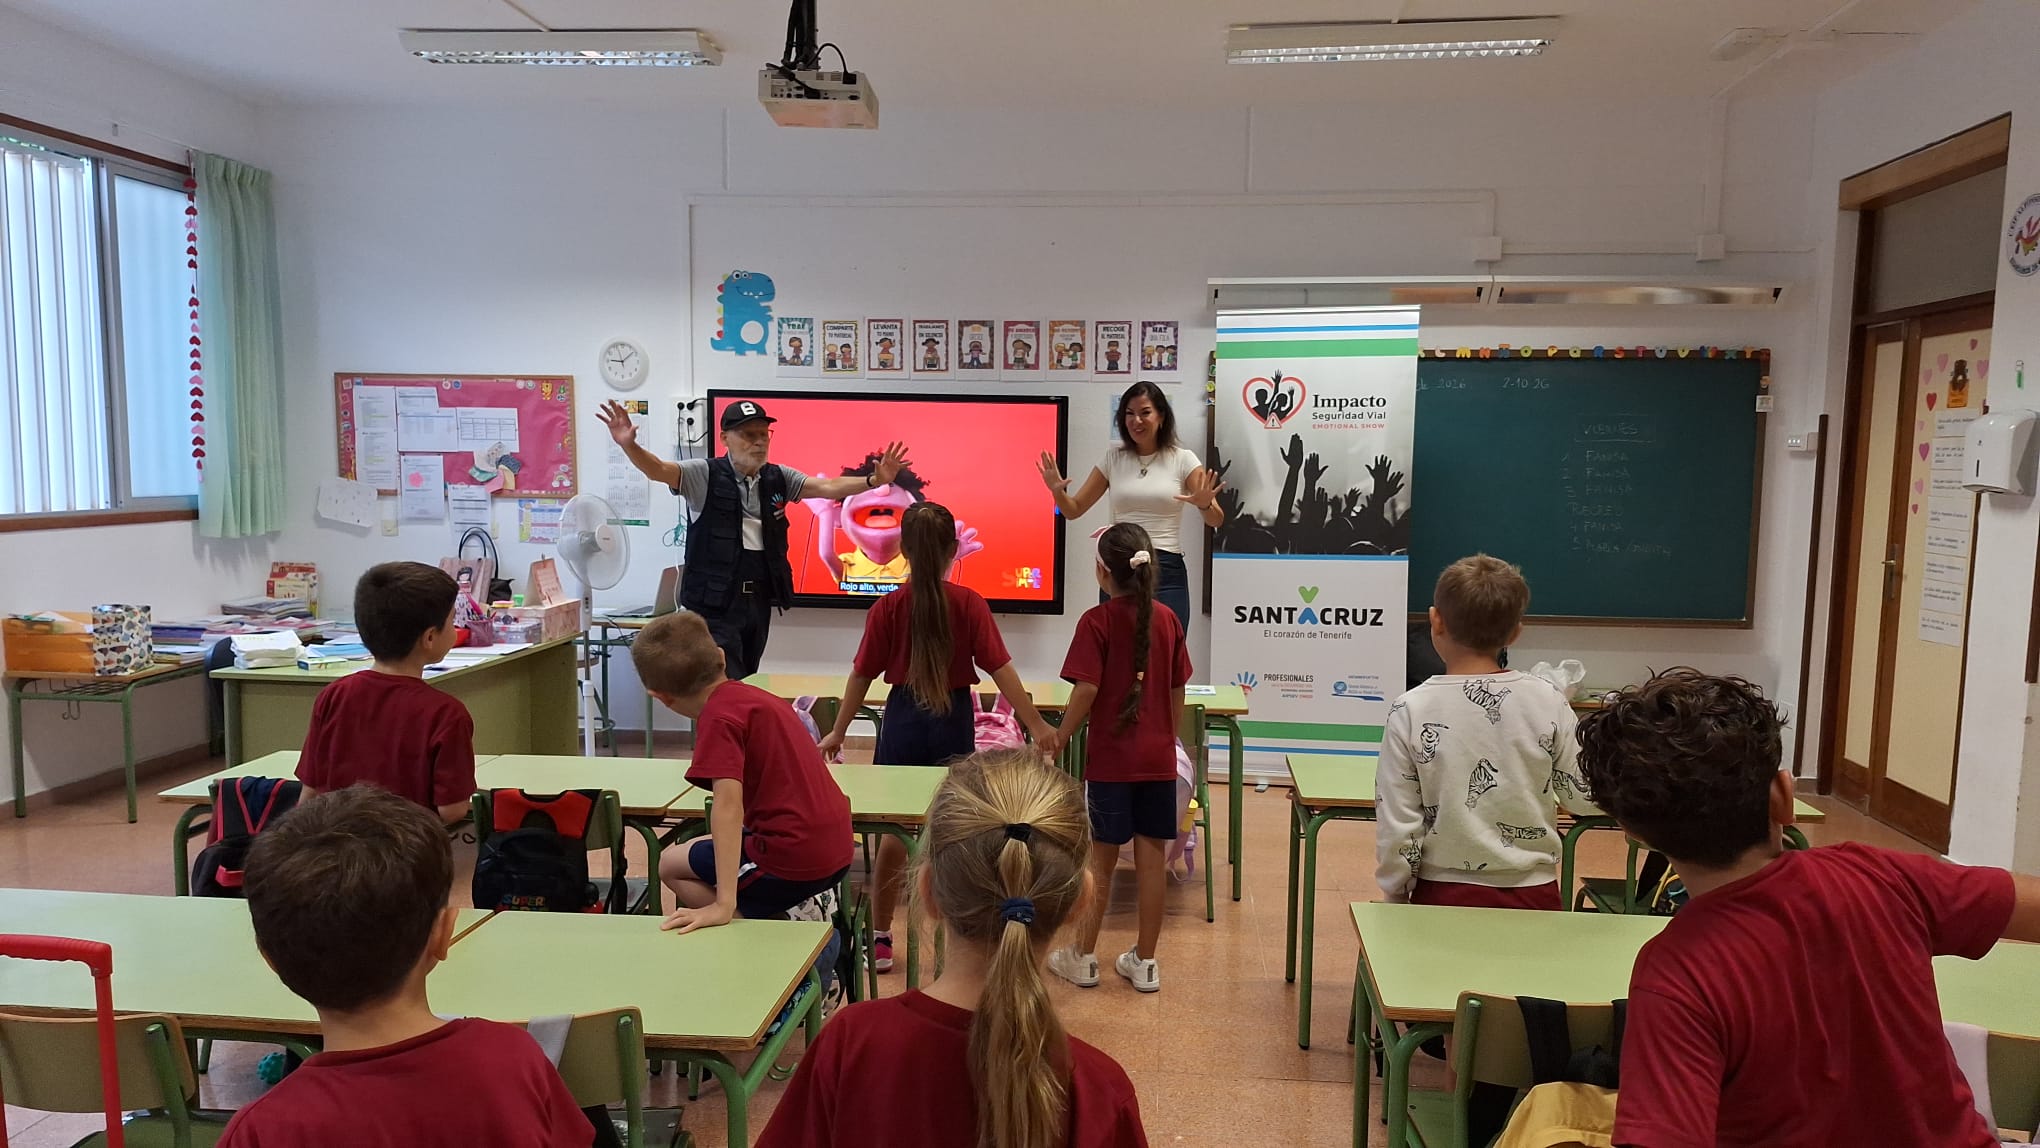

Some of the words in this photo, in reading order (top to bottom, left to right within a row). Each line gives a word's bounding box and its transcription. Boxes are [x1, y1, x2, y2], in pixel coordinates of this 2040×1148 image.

[1312, 394, 1387, 412] Impacto
[740, 401, 757, 416] B
[1312, 411, 1364, 421] Seguridad
[1366, 411, 1387, 420] Vial
[840, 582, 858, 592] Rojo
[1263, 630, 1271, 638] El
[1273, 630, 1305, 639] corazón
[1307, 631, 1317, 639] de
[1319, 631, 1352, 640] Tenerife
[1263, 673, 1314, 683] PROFESIONALES
